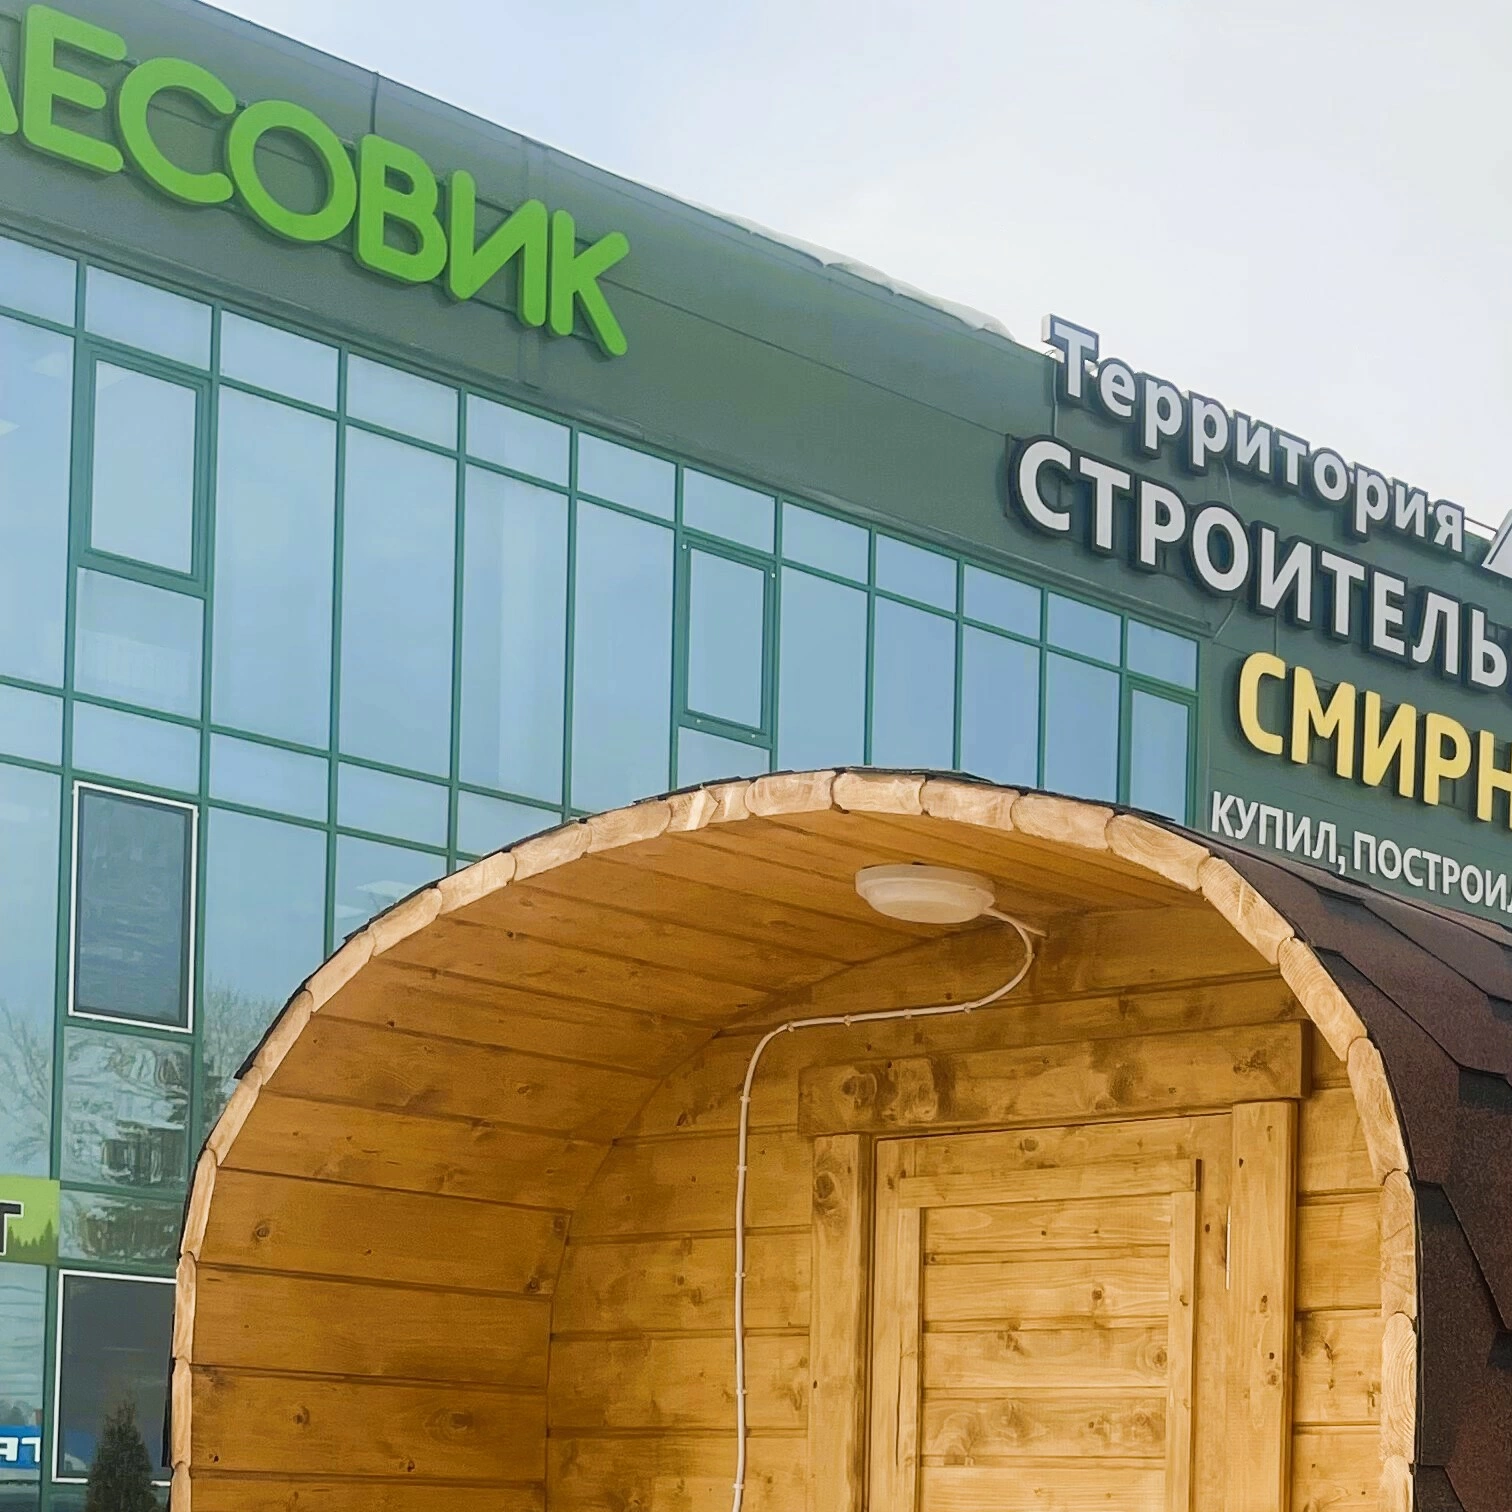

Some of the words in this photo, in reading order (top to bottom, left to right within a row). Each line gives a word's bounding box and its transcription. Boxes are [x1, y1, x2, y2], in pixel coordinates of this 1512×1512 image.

[0, 4, 629, 356] ЕСОВИК
[1045, 314, 1464, 554] Территория
[1210, 791, 1346, 875] КУПИЛ,
